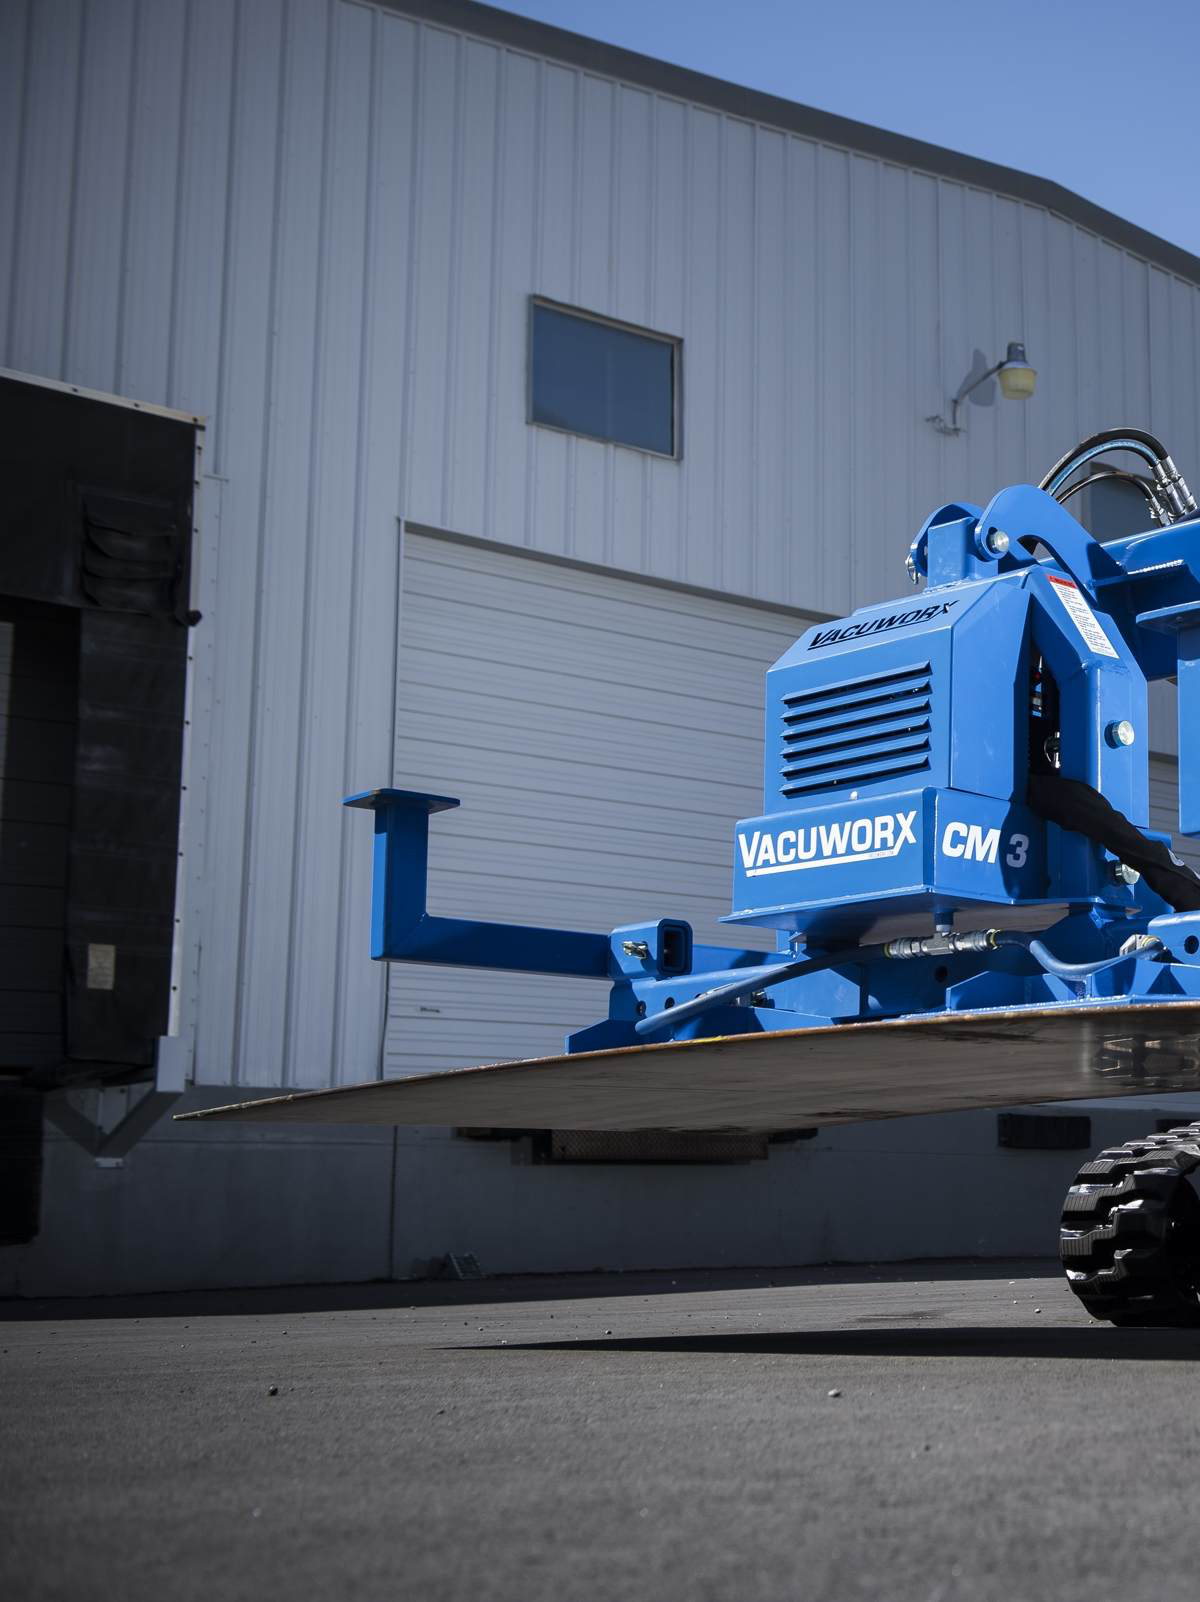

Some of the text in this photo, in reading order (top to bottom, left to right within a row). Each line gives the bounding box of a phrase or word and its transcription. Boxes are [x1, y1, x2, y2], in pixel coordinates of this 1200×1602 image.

[807, 600, 960, 650] VACUWORX
[738, 811, 917, 877] VACUWORX
[942, 821, 1029, 868] CM 3
